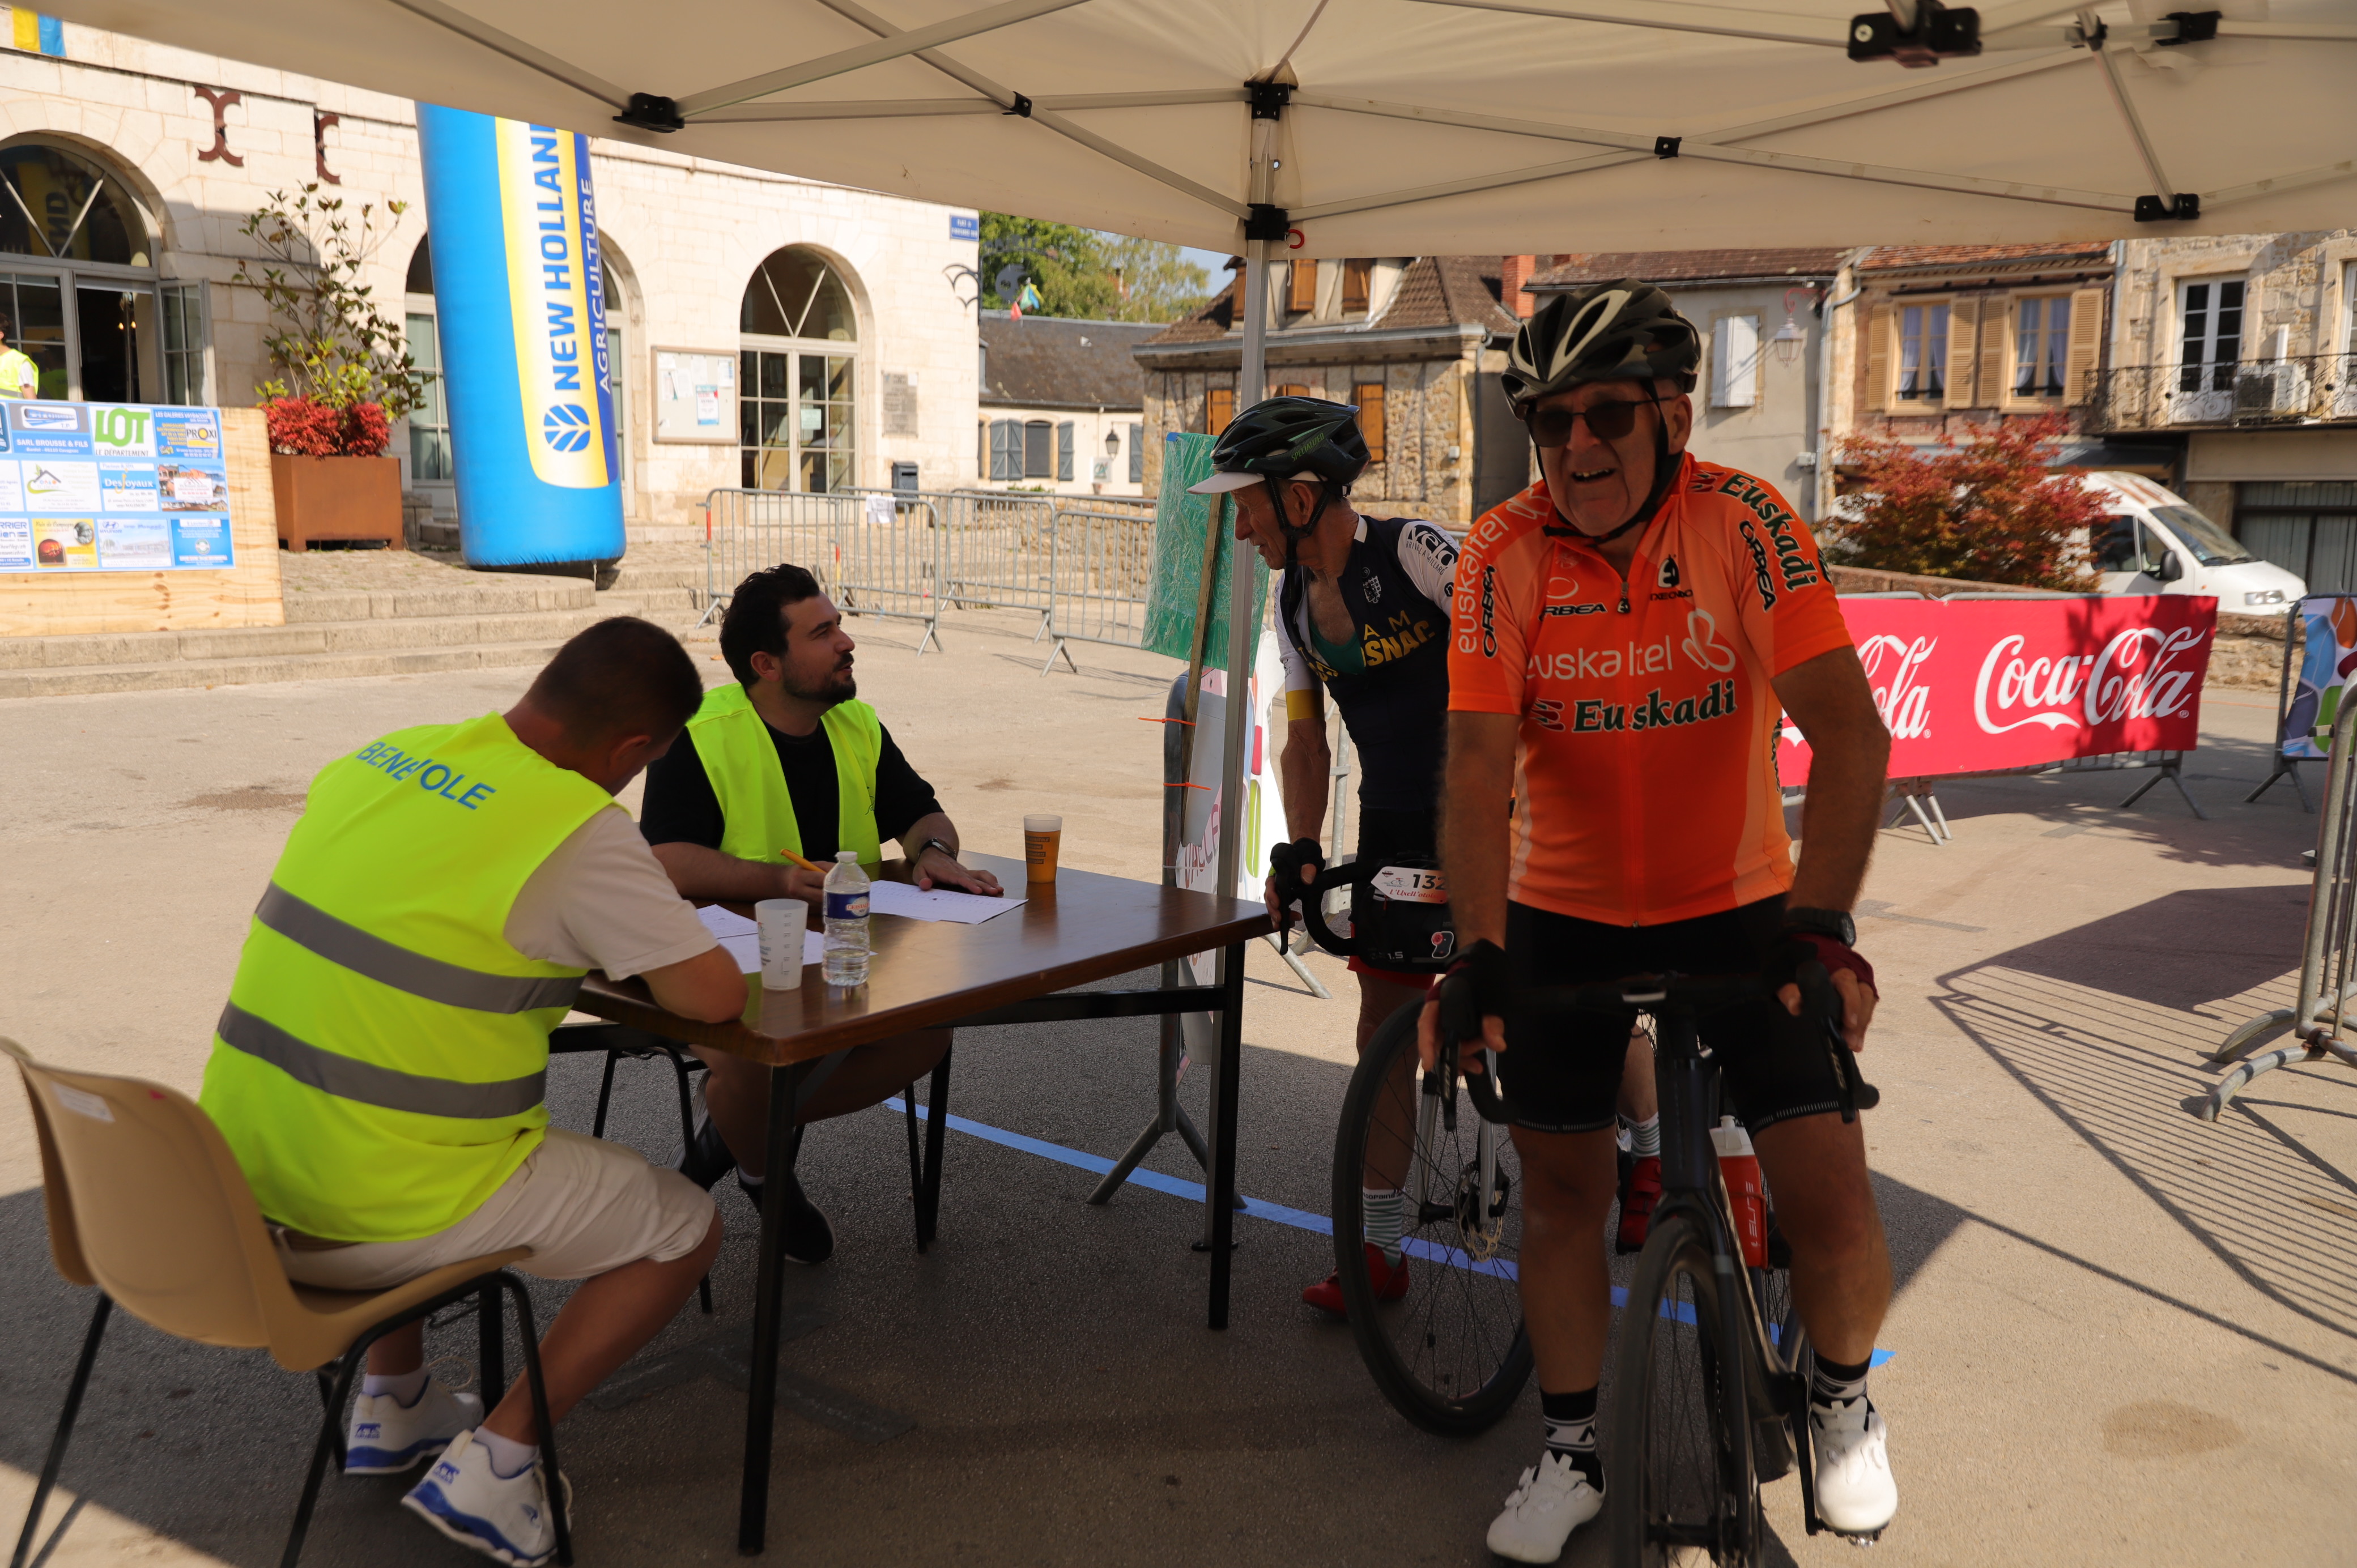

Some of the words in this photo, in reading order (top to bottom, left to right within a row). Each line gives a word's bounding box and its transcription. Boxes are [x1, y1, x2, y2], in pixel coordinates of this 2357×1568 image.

[580, 177, 610, 394] AGRICULTURE
[547, 302, 581, 391] NEW
[95, 408, 151, 448] LOT
[186, 428, 217, 440] PROXI
[1291, 432, 1325, 462] SPECIALIZED
[1718, 473, 1817, 593] Euskadi
[1739, 519, 1778, 612] ORBEA
[1457, 513, 1510, 655] euskaltel
[1481, 564, 1499, 659] ORBEA
[1572, 678, 1738, 734] Euskadi
[1974, 627, 2206, 734] Coca-Cola
[1388, 951, 1403, 960] 1.5
